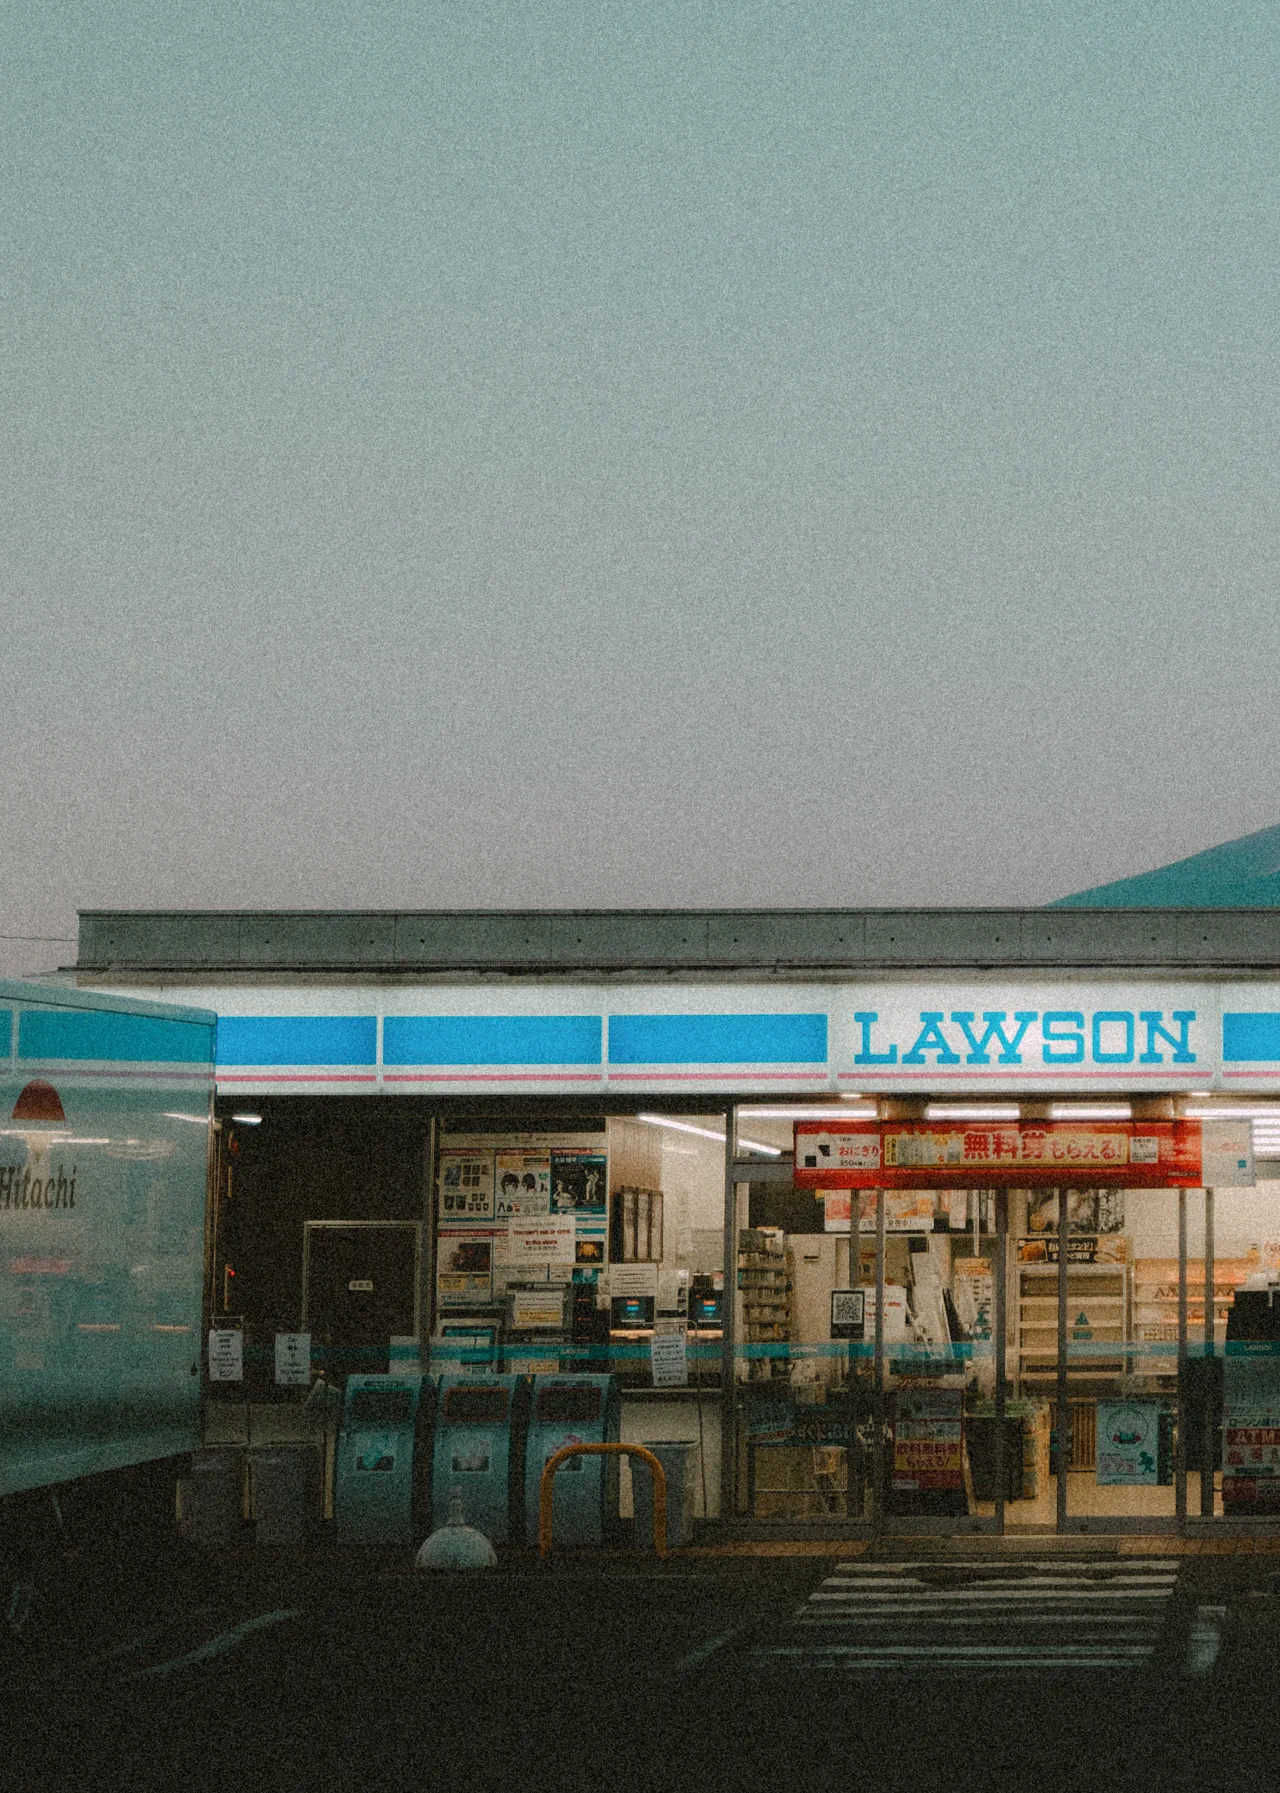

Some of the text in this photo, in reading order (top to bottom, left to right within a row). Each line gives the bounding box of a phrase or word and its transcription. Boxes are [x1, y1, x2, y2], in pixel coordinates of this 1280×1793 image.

[854, 1011, 1196, 1064] LAWSON
[838, 1146, 880, 1157] おにぎり
[0, 1163, 76, 1210] Hitachi
[1234, 1430, 1276, 1443] ATM
